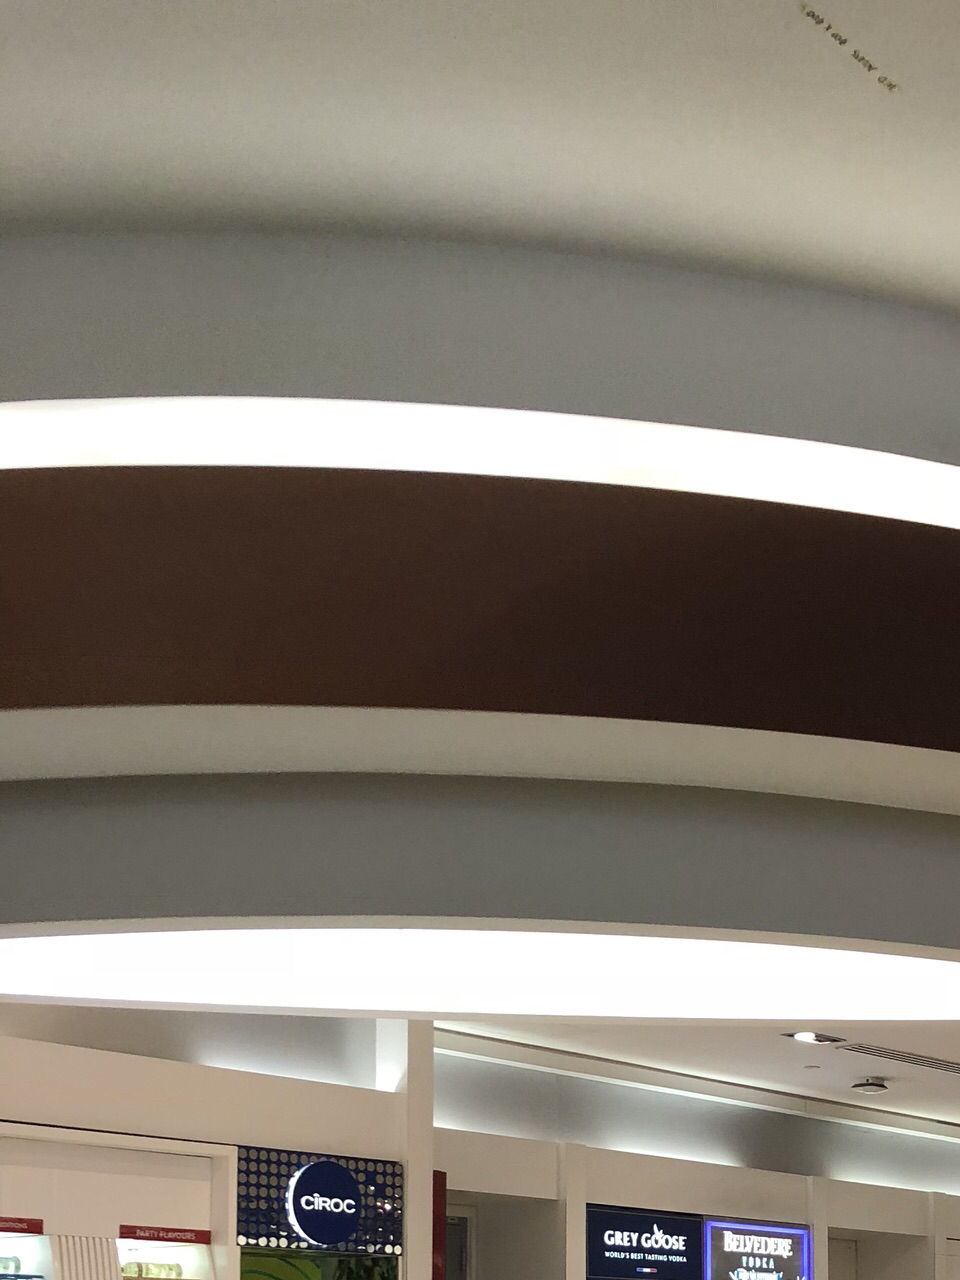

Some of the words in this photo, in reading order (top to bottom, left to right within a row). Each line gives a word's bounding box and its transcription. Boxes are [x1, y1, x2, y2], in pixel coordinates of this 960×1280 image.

[136, 1229, 158, 1238] PARTY
[159, 1230, 196, 1240] FLAVOURS
[603, 1230, 639, 1247] GREY
[640, 1226, 687, 1250] GOOSE
[723, 1230, 794, 1258] BELVEDERE
[604, 1250, 629, 1259] WORLD'S
[630, 1252, 644, 1260] BEST
[644, 1253, 668, 1262] TASTING
[668, 1255, 688, 1263] VODKA
[741, 1256, 775, 1269] VODKA
